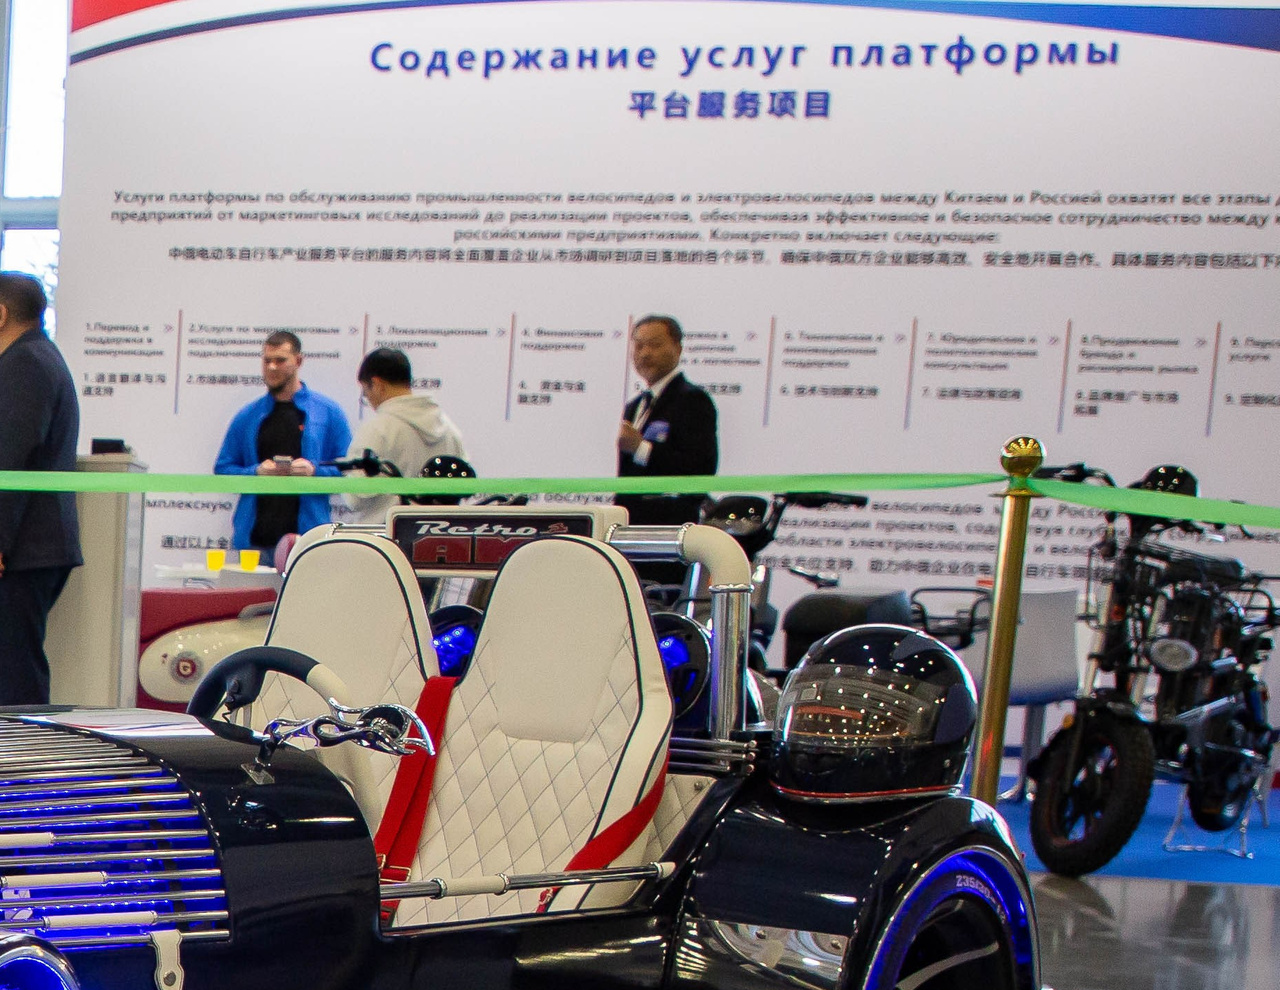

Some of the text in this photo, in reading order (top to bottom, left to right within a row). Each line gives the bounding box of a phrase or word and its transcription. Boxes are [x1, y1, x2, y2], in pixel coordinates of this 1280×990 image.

[370, 35, 1120, 79] Содержание услуг платформы
[628, 90, 832, 119] 平台服务项目
[114, 190, 164, 206] Услуги
[169, 190, 261, 208] платформы
[265, 193, 285, 204] по
[288, 190, 411, 206] обслуживанию
[415, 192, 562, 206] промышленности
[567, 193, 676, 206] велосипедов
[681, 193, 691, 204] и
[878, 193, 939, 207] между
[943, 190, 1008, 206] Китаем
[1012, 193, 1025, 205] и
[1029, 189, 1103, 206] Россией
[1107, 194, 1176, 206] охватят
[1181, 194, 1212, 206] все
[1217, 194, 1272, 207] этапы
[110, 208, 213, 224] предприятий
[217, 210, 234, 222] от
[238, 210, 361, 224] маркетинговых
[366, 208, 480, 224] исследований
[484, 211, 505, 223] до
[509, 210, 608, 224] реализации
[700, 208, 809, 224] обеспечивая
[815, 210, 930, 226] эффективное
[935, 212, 946, 223] и
[950, 209, 1052, 225] безопасное
[1058, 211, 1202, 227] сотрудничество
[1207, 213, 1269, 228] между
[144, 497, 233, 513] мплексную
[414, 519, 538, 537] Retro
